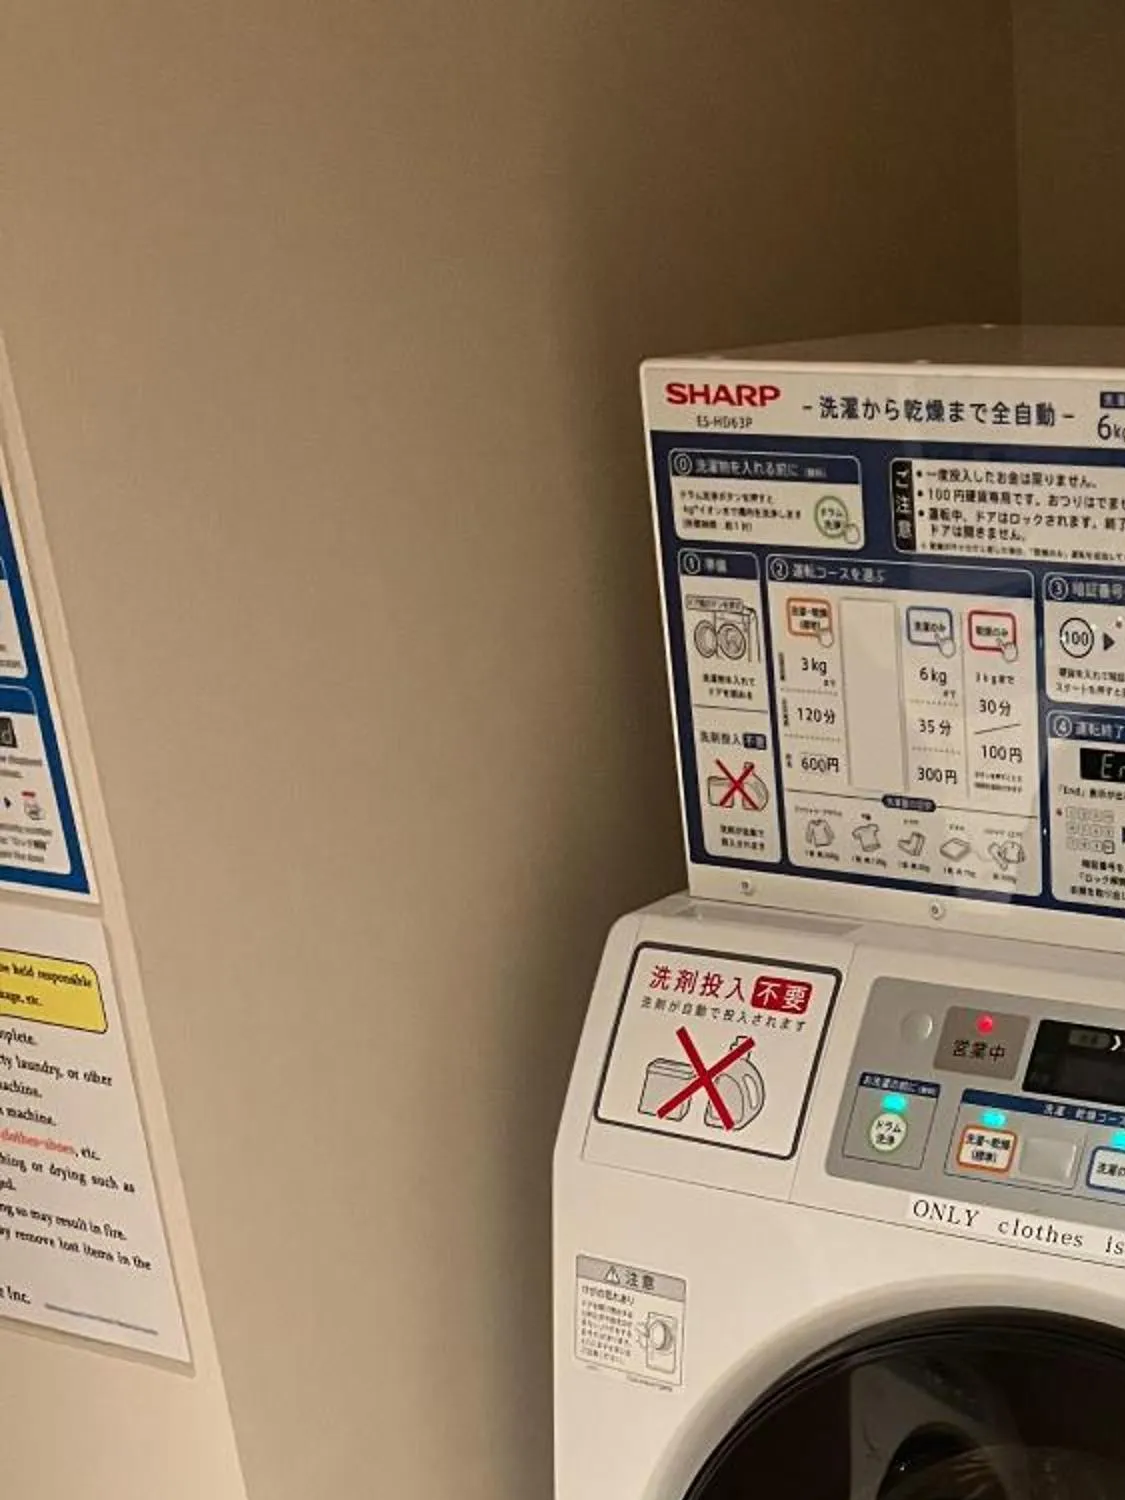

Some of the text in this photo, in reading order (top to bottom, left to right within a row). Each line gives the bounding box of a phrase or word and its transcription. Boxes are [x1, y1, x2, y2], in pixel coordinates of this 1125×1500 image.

[665, 383, 782, 407] SHARP
[1064, 631, 1089, 646] 100
[801, 657, 827, 676] 3kg
[919, 667, 947, 686] 6kg
[797, 707, 836, 724] 120分
[979, 699, 1012, 717] 30分
[919, 719, 951, 736] 35分
[981, 745, 1023, 763] 100円
[801, 757, 839, 773] 600円
[918, 767, 957, 784] 300円
[12, 963, 34, 977] held
[38, 970, 92, 987] responsible
[649, 964, 806, 1011] 洗剤投入 不要
[640, 996, 807, 1033] 洗剤が自動で投入されます
[952, 1039, 1006, 1063] 営業中
[16, 1054, 63, 1080] laundry,
[68, 1069, 79, 1079] or
[84, 1070, 112, 1086] other
[6, 1107, 57, 1126] machine.
[32, 1162, 43, 1172] or
[50, 1164, 87, 1186] drying
[91, 1175, 118, 1190] such
[124, 1182, 135, 1193] as
[15, 1207, 28, 1217] so
[30, 1209, 52, 1225] may
[55, 1216, 87, 1232] result
[90, 1221, 101, 1234] in
[104, 1223, 127, 1240] fire.
[911, 1199, 980, 1228] ONLY
[997, 1218, 1084, 1249] clothes
[1105, 1235, 1125, 1255] is
[15, 1231, 55, 1247] remove
[58, 1237, 80, 1253] lost
[83, 1242, 114, 1262] items
[117, 1252, 131, 1266] in
[133, 1256, 151, 1270] the
[7, 1285, 31, 1304] Inc.
